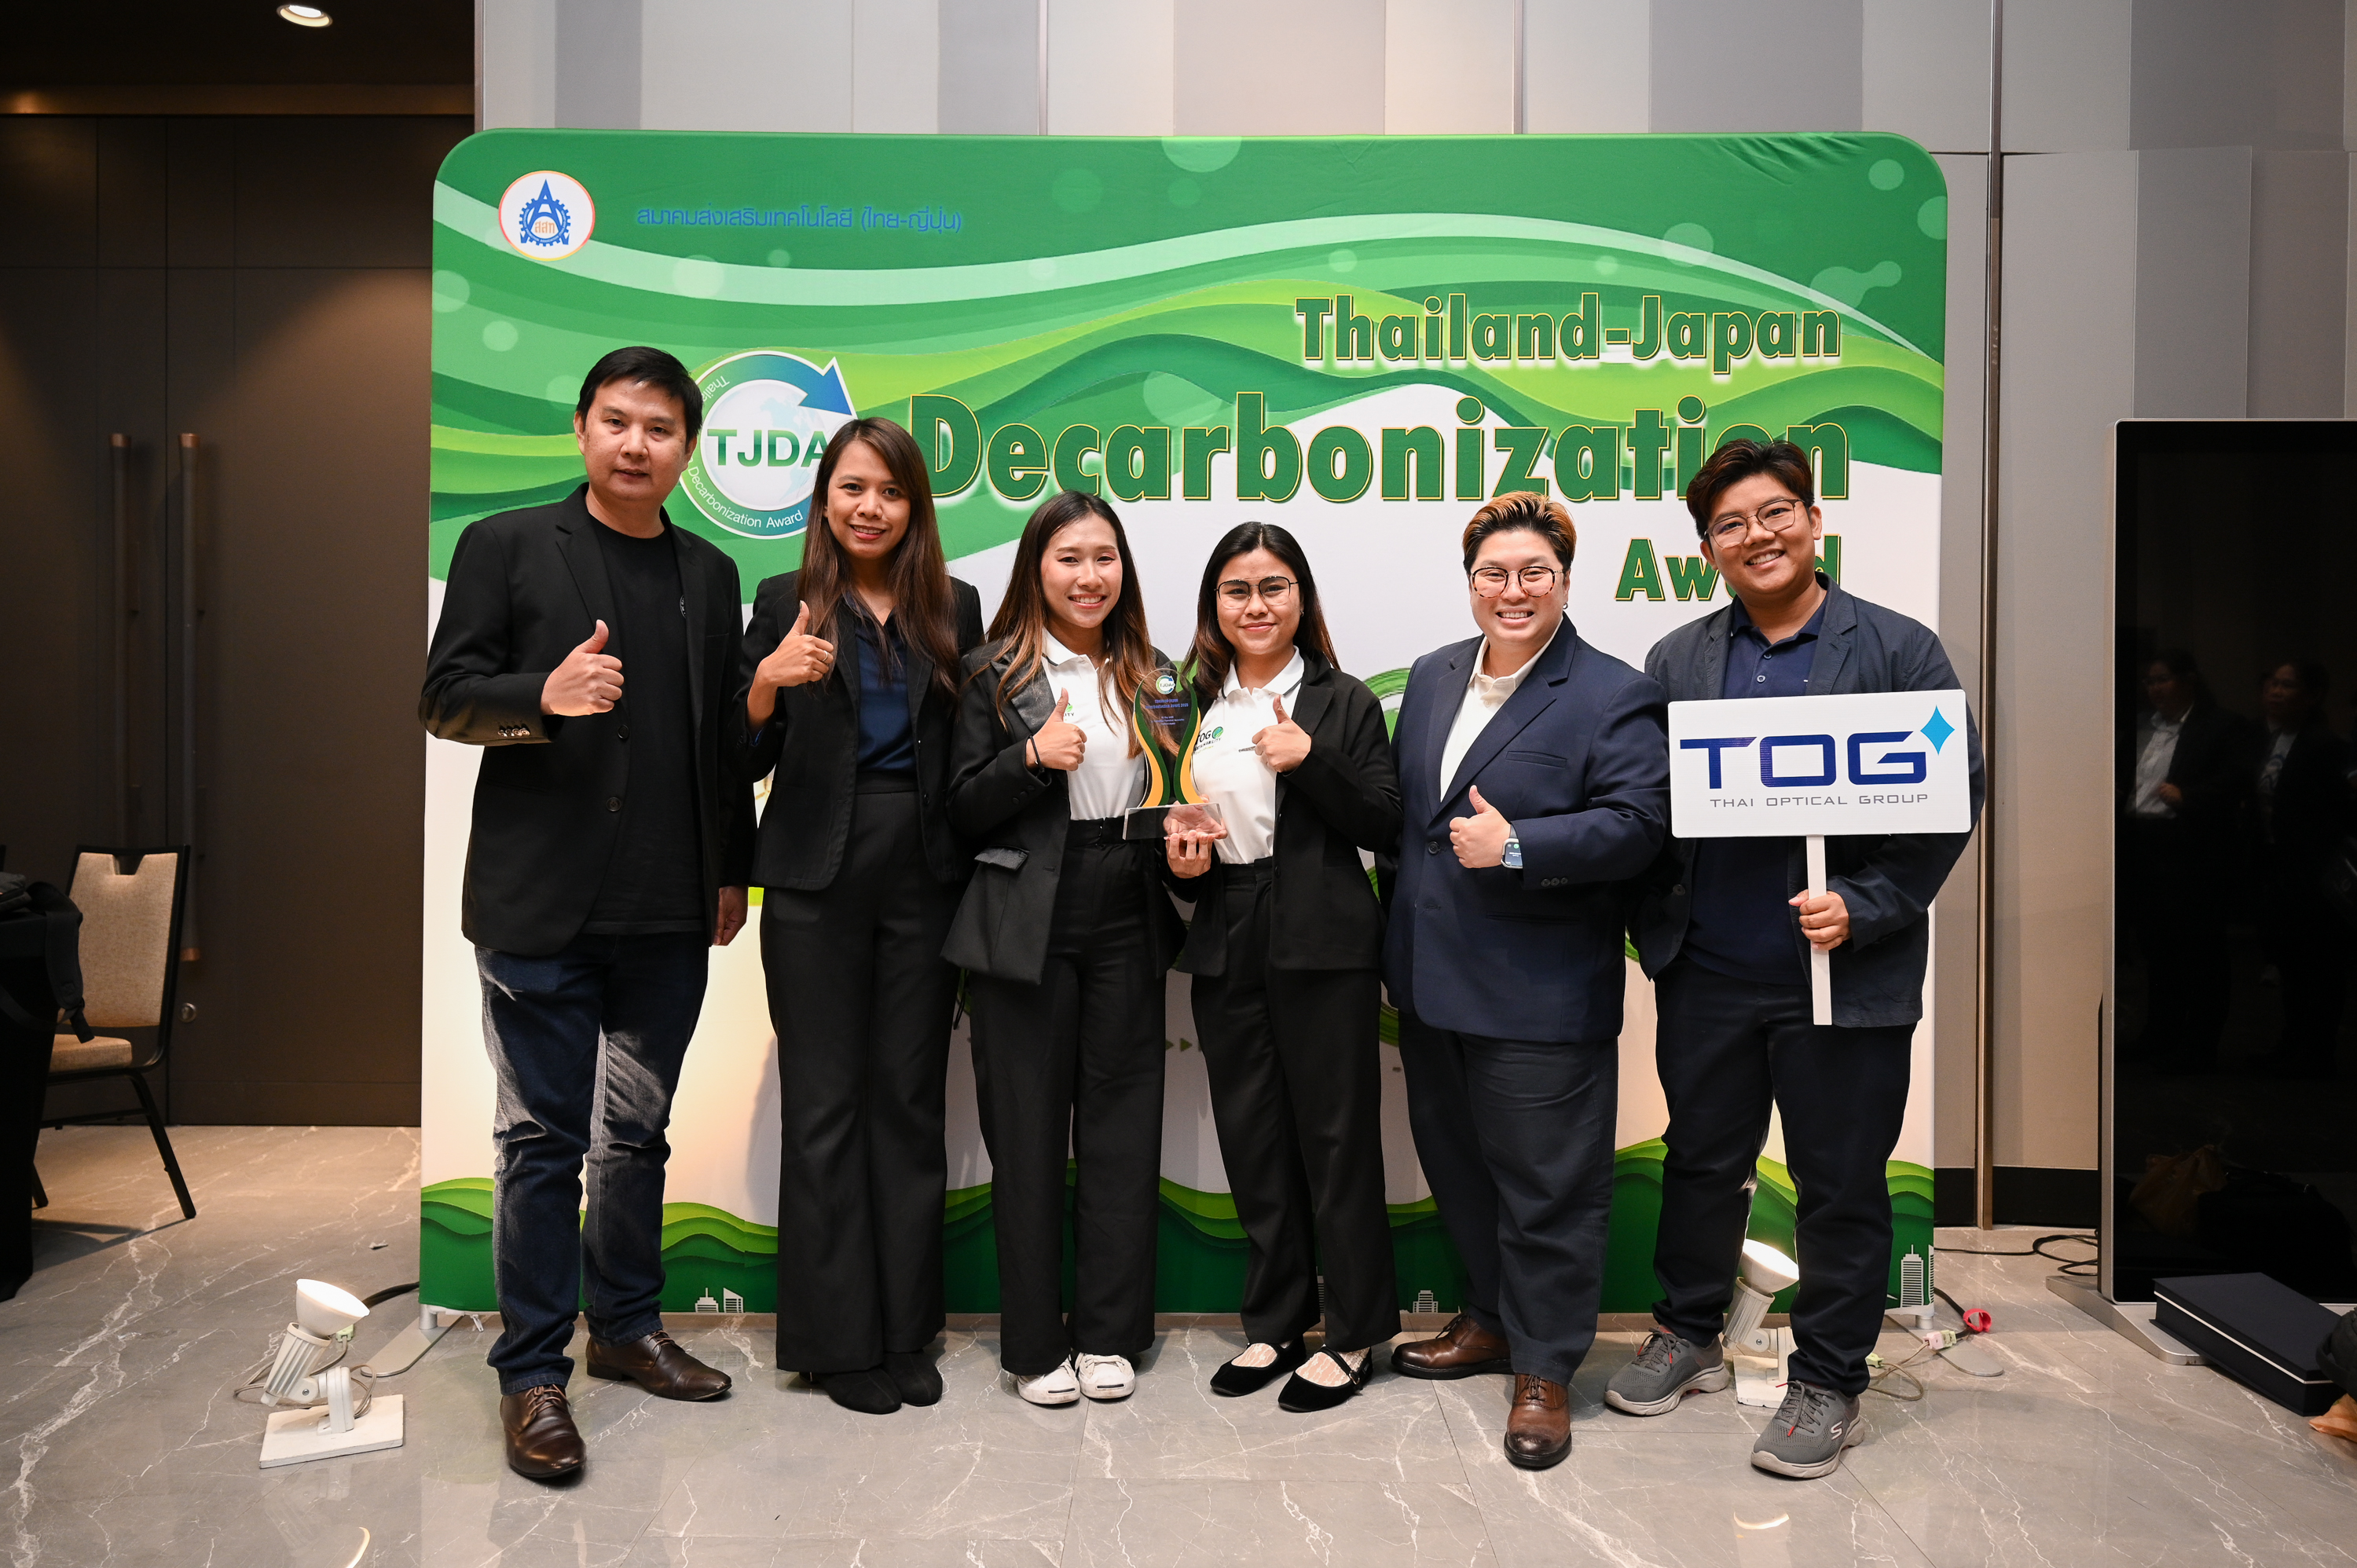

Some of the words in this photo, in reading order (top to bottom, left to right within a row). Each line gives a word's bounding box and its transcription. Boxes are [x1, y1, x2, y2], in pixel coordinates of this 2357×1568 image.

[637, 203, 852, 226] สมาคมส่งเสริมเทคโนโลยี
[1296, 292, 1840, 375] Thailand-Japan
[909, 391, 1849, 503] Decarbonizatin
[687, 466, 761, 528] Decarbonization
[766, 510, 803, 529] Award
[1614, 534, 1841, 600] Awd
[1680, 731, 1927, 789] TOG
[1710, 797, 1754, 808] THAI
[1766, 796, 1848, 807] OPTICAL
[1859, 793, 1928, 804] GROUP
